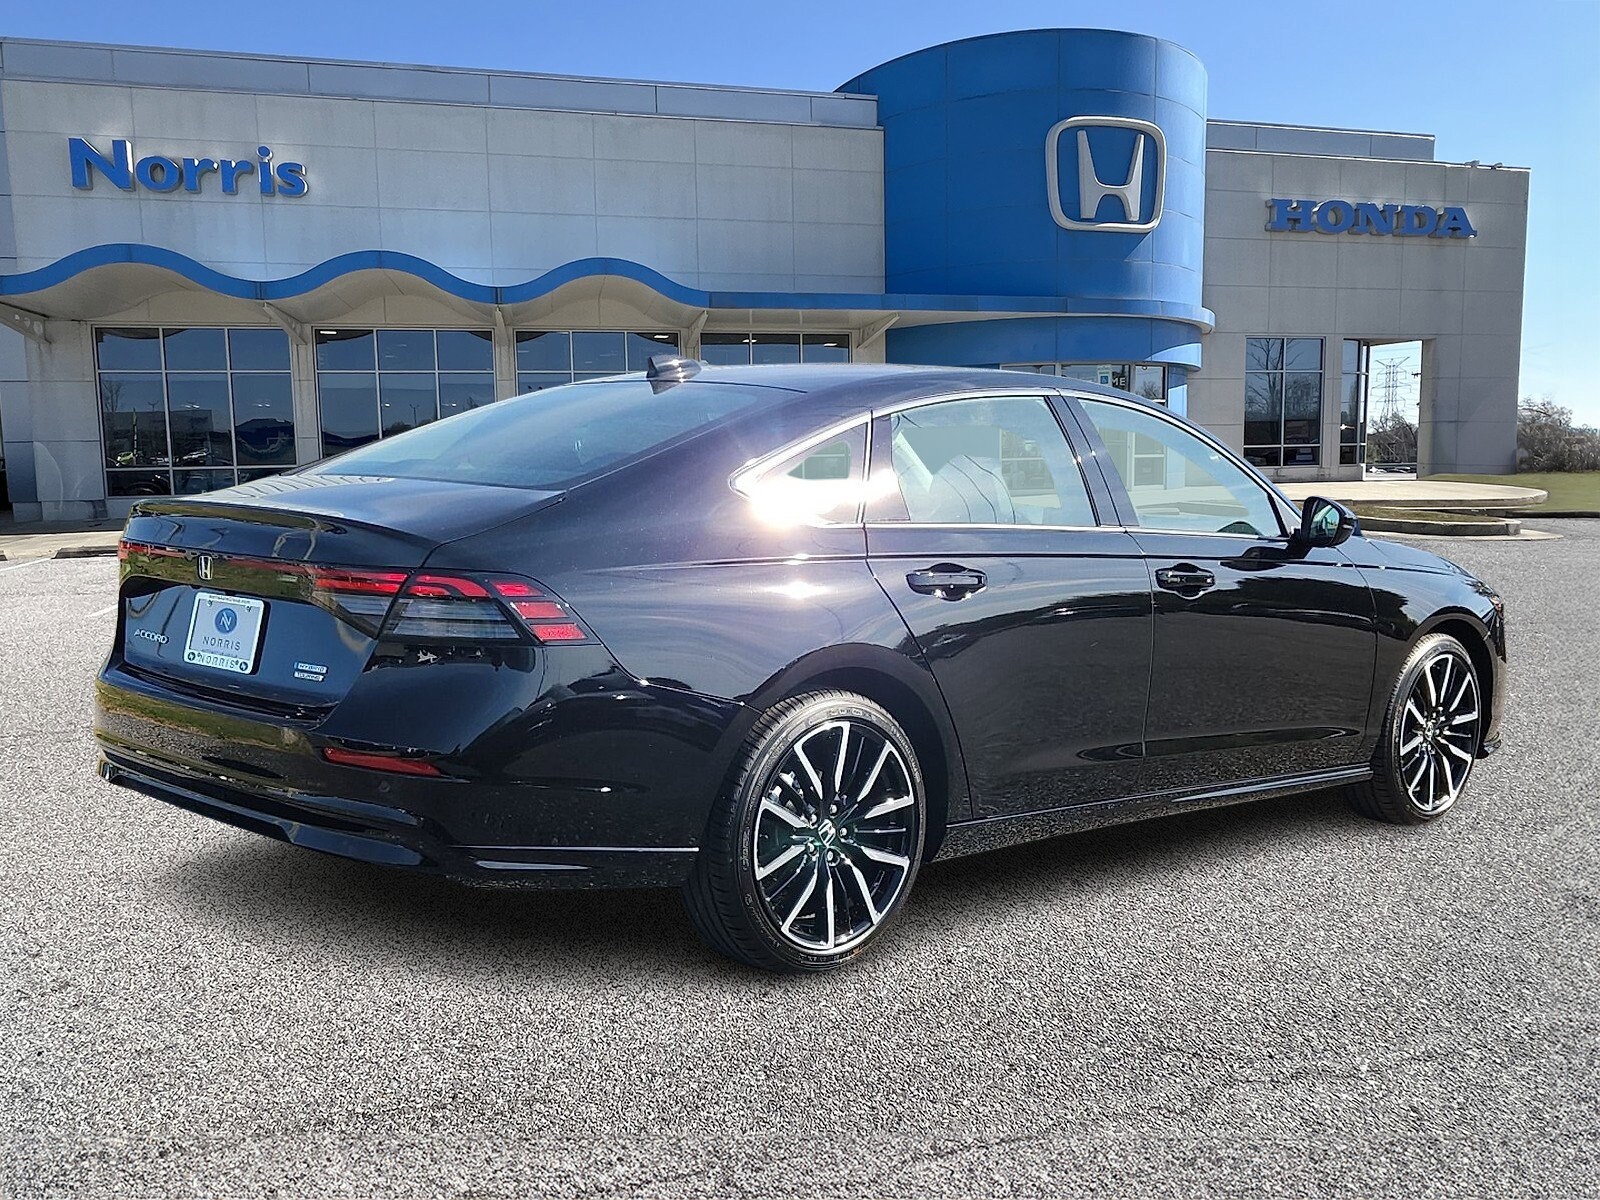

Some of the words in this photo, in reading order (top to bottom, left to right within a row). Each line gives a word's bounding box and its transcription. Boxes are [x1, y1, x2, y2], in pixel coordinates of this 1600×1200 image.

[68, 138, 309, 197] Norris
[1265, 198, 1478, 239] HONDA
[134, 629, 168, 644] ACCORD
[202, 636, 241, 651] NORRIS
[198, 655, 236, 669] NORRIS
